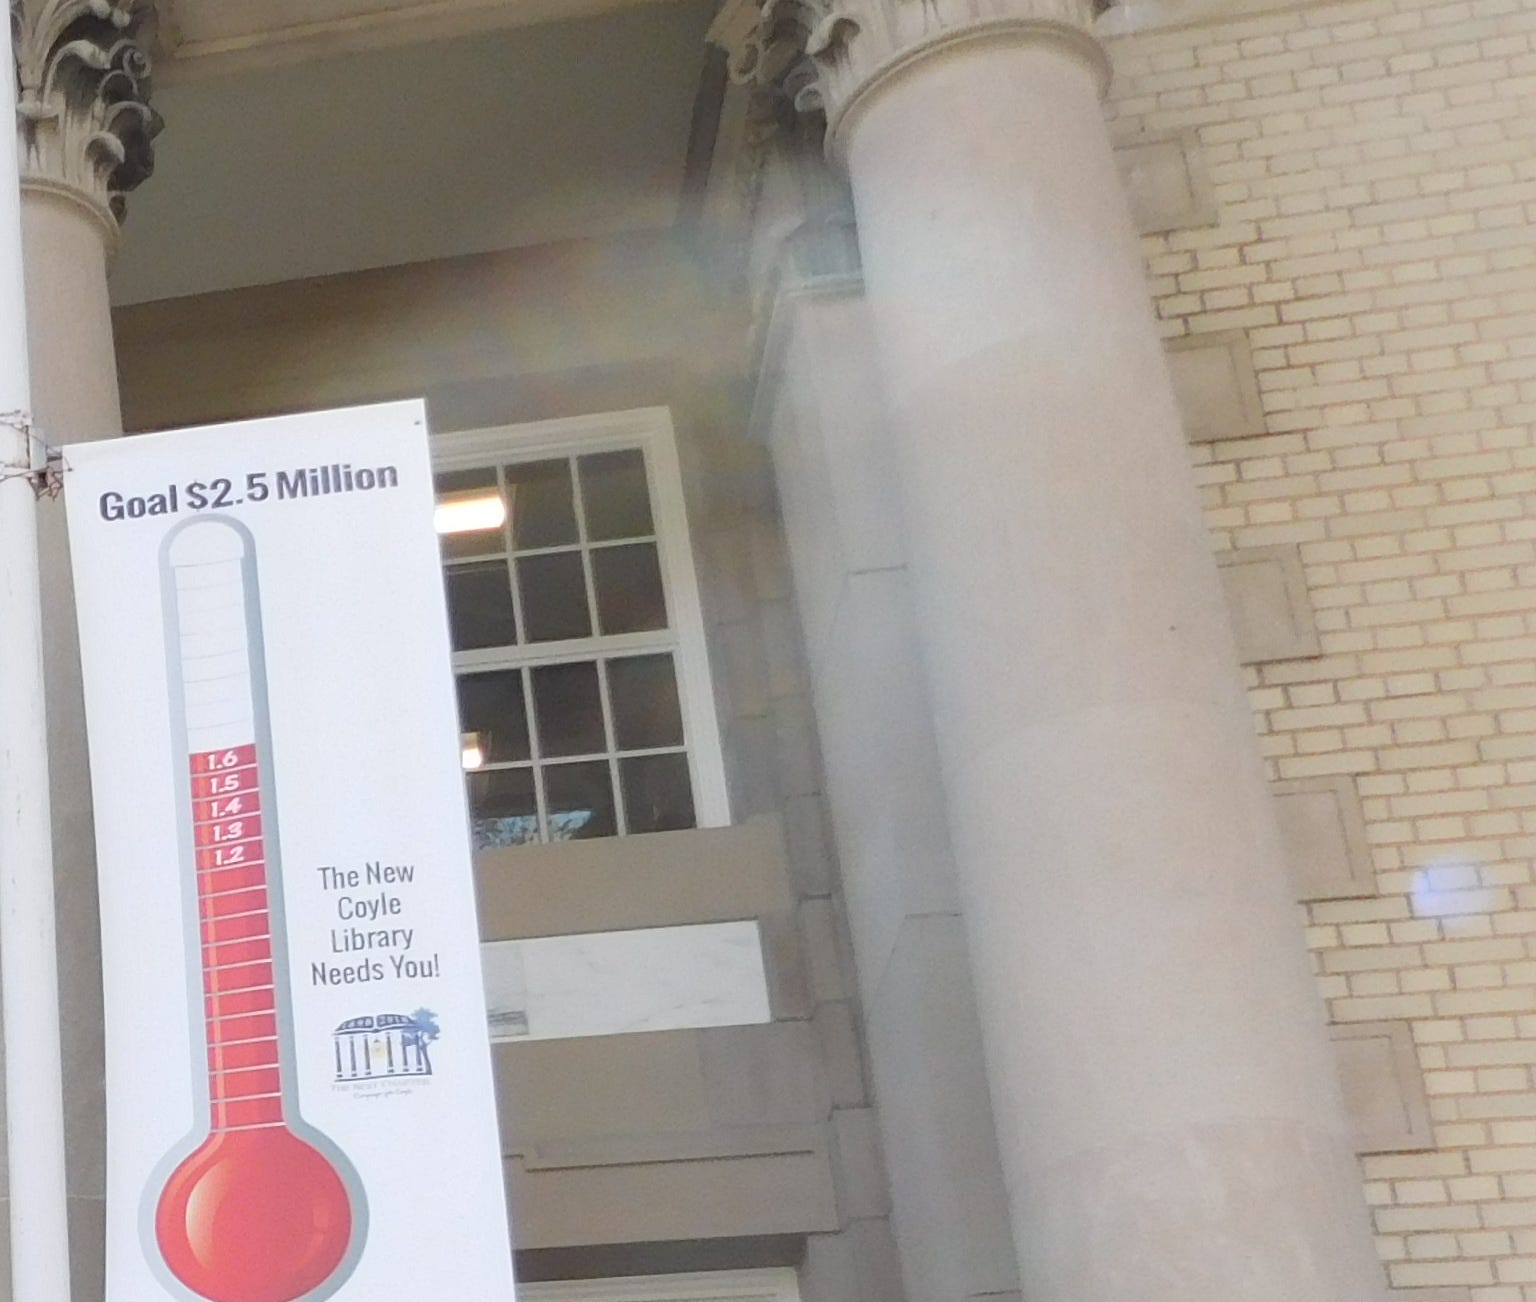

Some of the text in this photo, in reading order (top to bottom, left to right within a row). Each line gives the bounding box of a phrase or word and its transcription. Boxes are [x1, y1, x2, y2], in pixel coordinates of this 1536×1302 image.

[99, 463, 399, 521] Goal $2.5 Million
[207, 750, 238, 770] 1.6
[210, 774, 240, 794] 1.5
[211, 797, 242, 818] 1.4
[213, 822, 243, 842] 1.3
[215, 846, 245, 866] 1.2
[317, 862, 415, 891] The New
[337, 893, 402, 920] Coyle
[330, 925, 414, 954] Library
[311, 953, 440, 987] Needs You!
